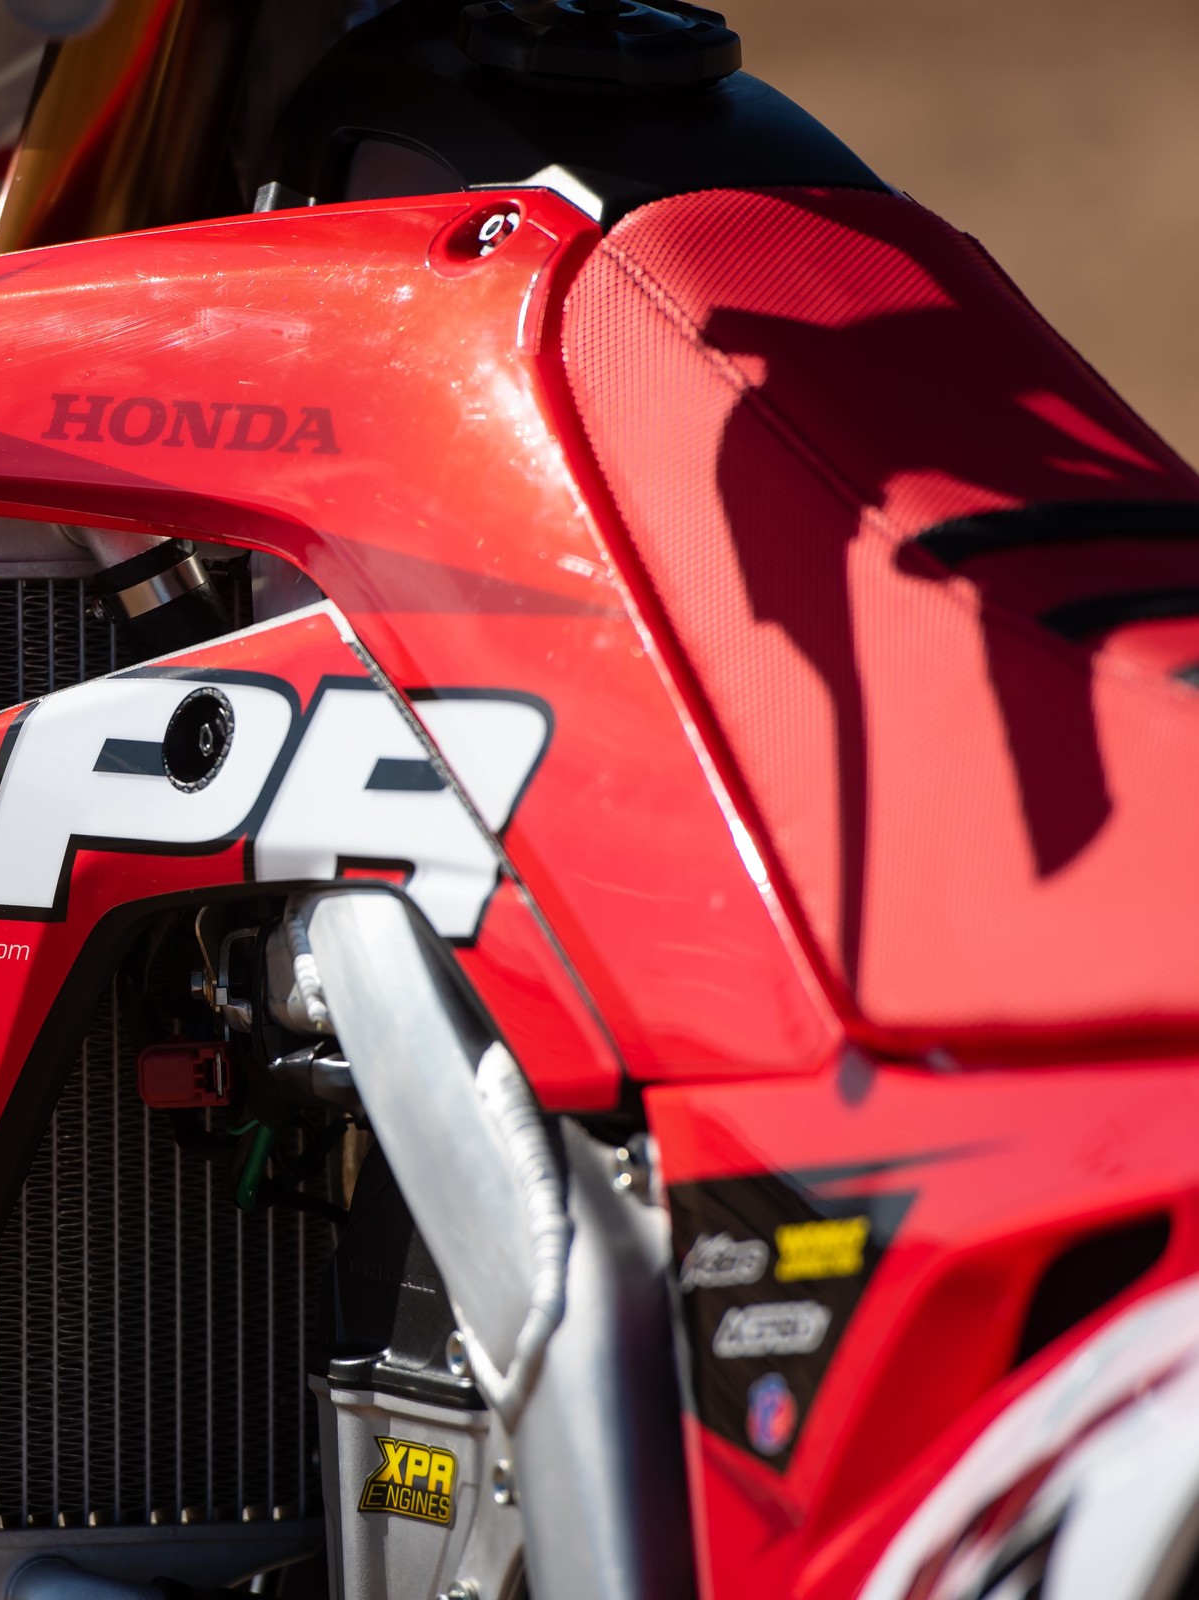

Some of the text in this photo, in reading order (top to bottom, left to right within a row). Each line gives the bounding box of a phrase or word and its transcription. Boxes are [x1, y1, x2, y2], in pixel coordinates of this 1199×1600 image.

[42, 393, 340, 454] HONDA
[376, 1442, 455, 1494] XPR
[365, 1484, 450, 1522] ENGINES
